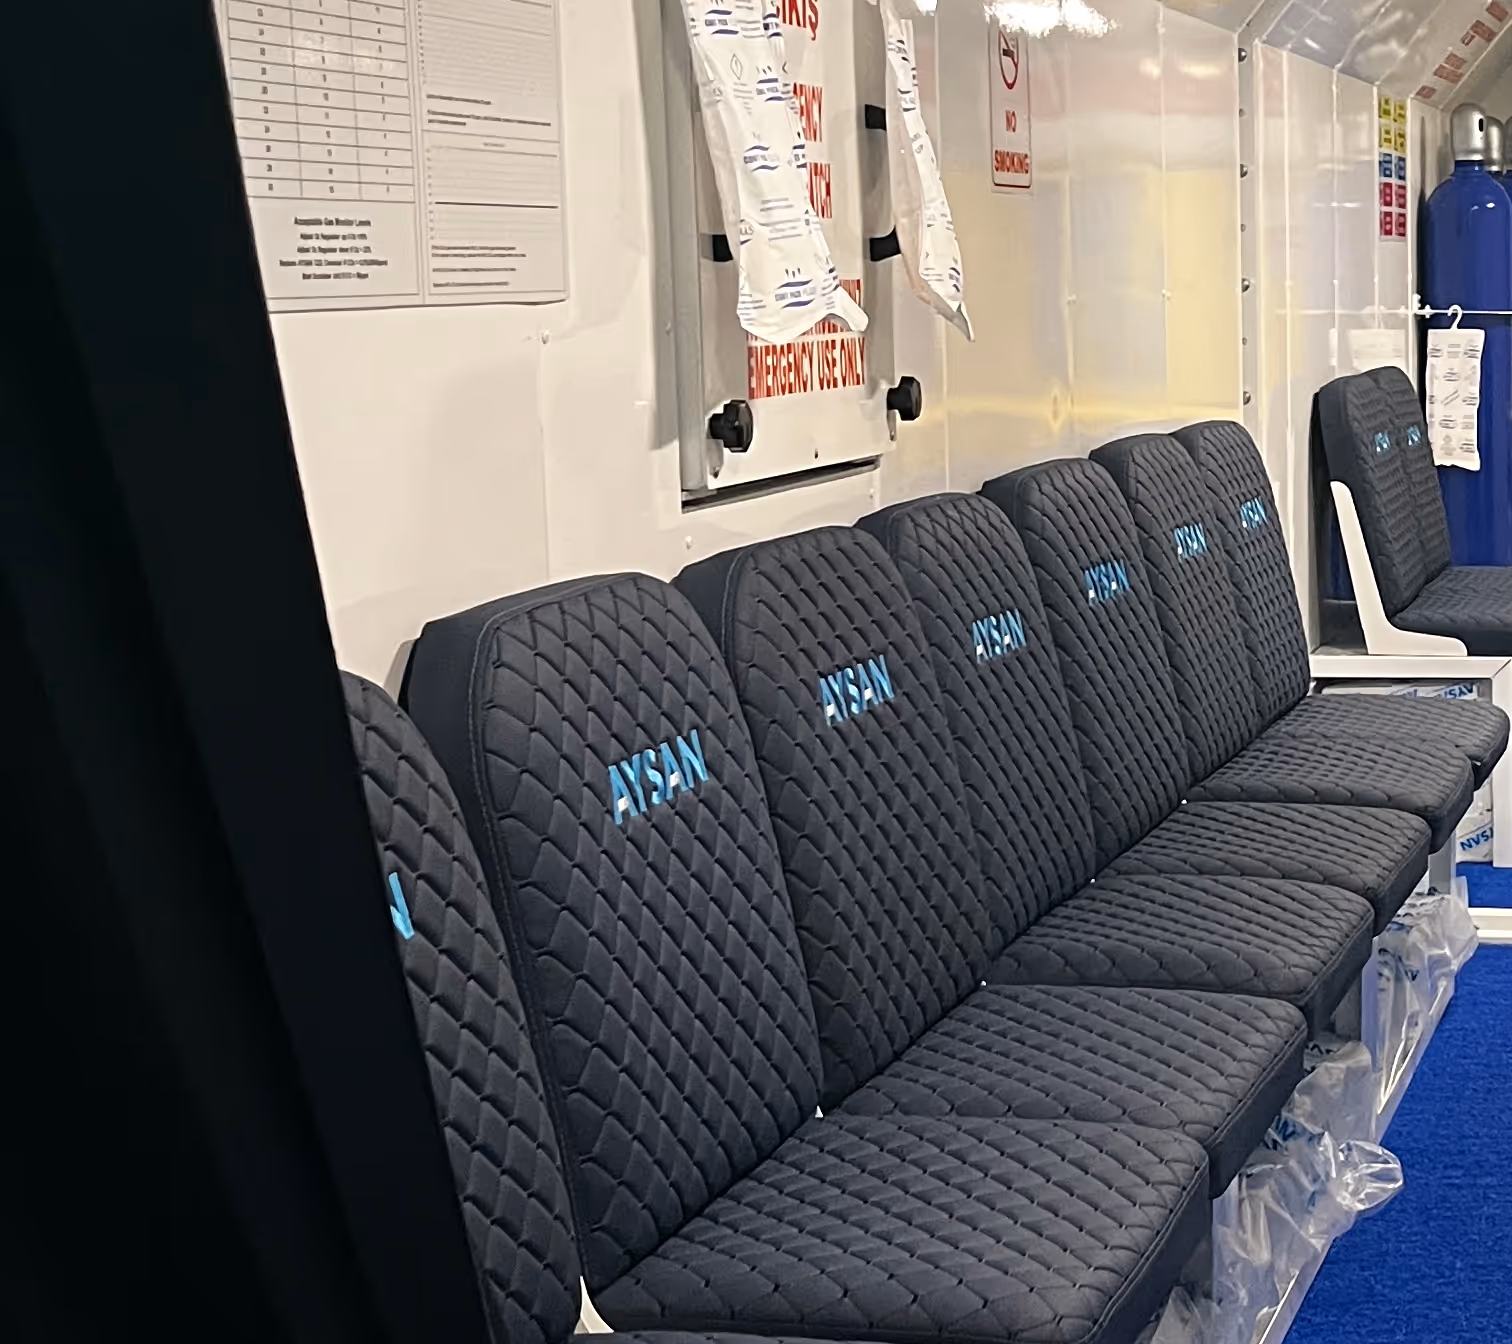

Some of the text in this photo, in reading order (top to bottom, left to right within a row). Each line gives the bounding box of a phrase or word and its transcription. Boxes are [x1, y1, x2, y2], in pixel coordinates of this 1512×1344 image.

[1005, 111, 1017, 133] NO
[994, 149, 1029, 174] SMOKING
[747, 336, 866, 400] EMERGENCY USE ONLY
[972, 607, 1027, 665] AYSAN
[819, 653, 895, 727] AYSAN
[607, 727, 710, 826] AYSAN
[1459, 827, 1494, 852] SAN
